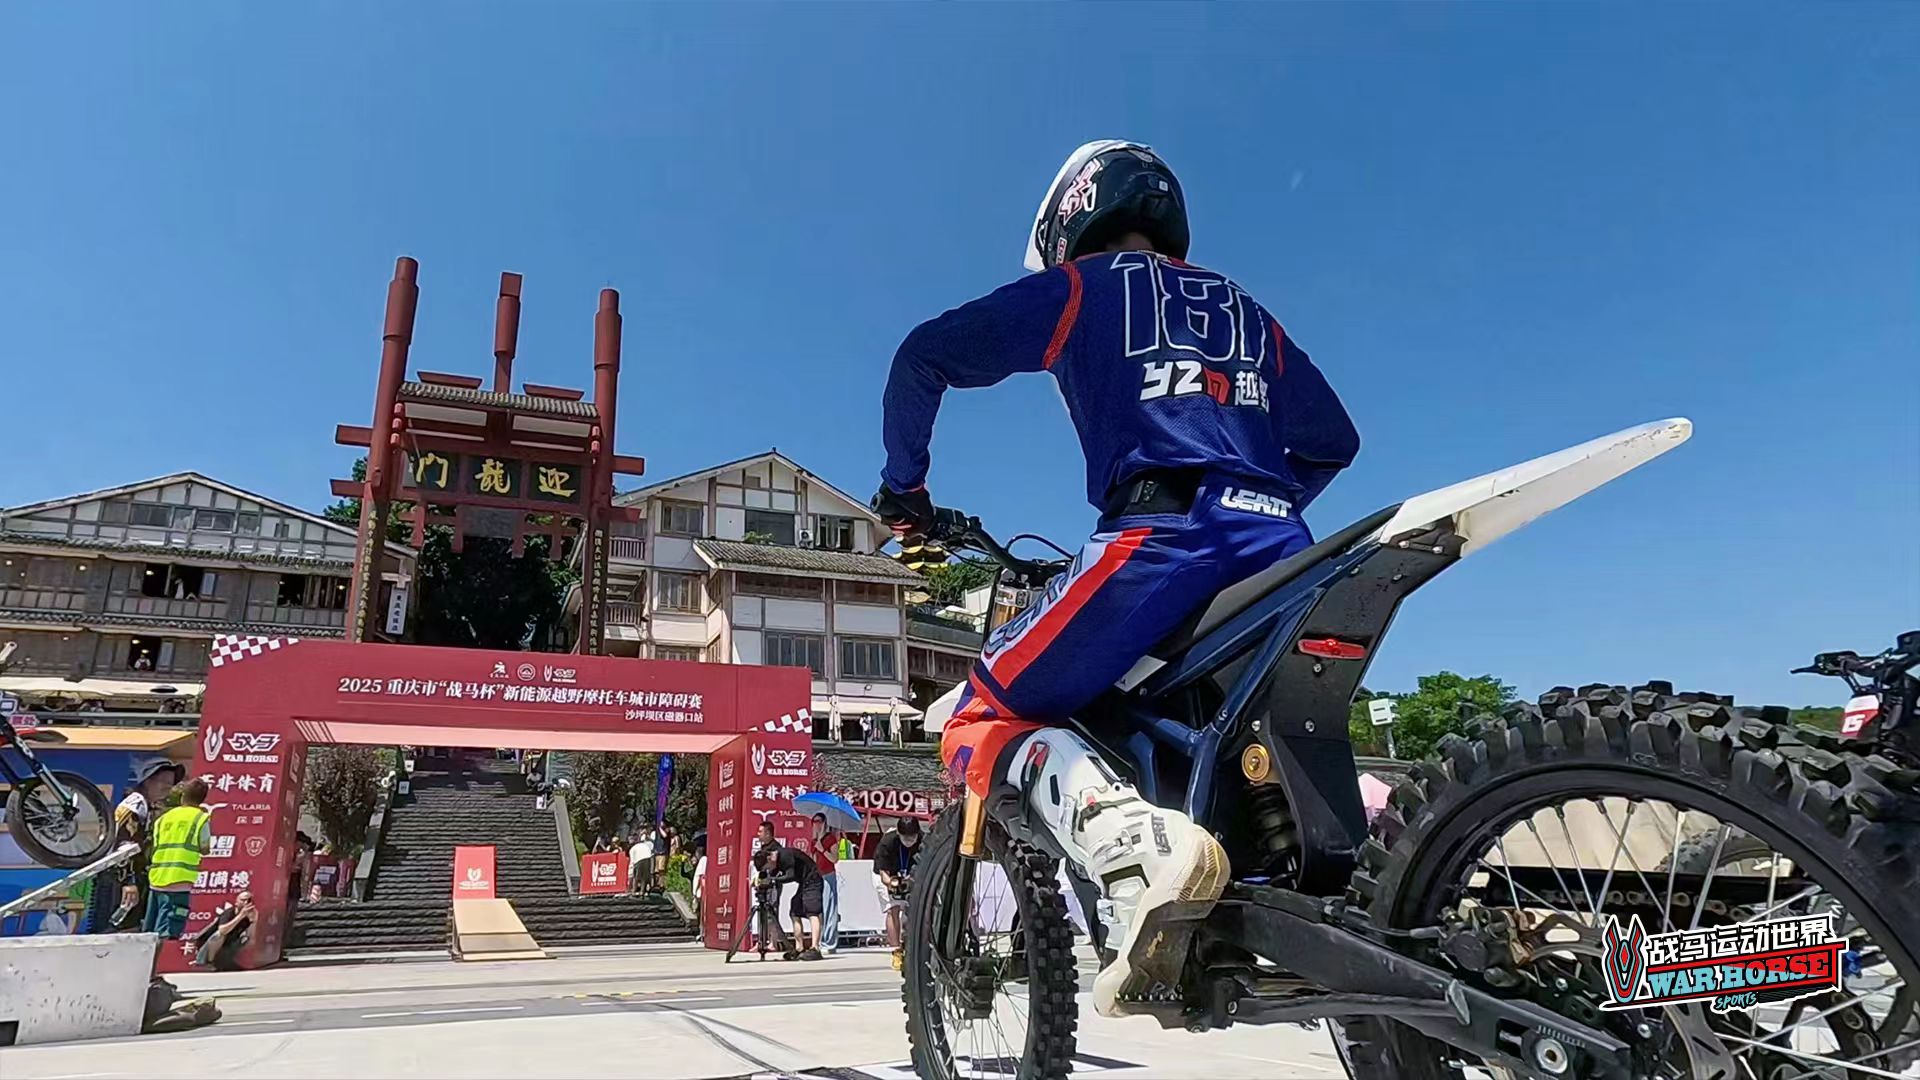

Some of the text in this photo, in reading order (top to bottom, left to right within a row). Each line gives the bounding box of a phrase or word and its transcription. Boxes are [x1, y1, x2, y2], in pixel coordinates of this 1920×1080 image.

[338, 678, 382, 692] 2025
[624, 709, 704, 723] 沙坪坝区磁器口站
[222, 754, 279, 763] WAR HORSE
[766, 768, 782, 776] WAR
